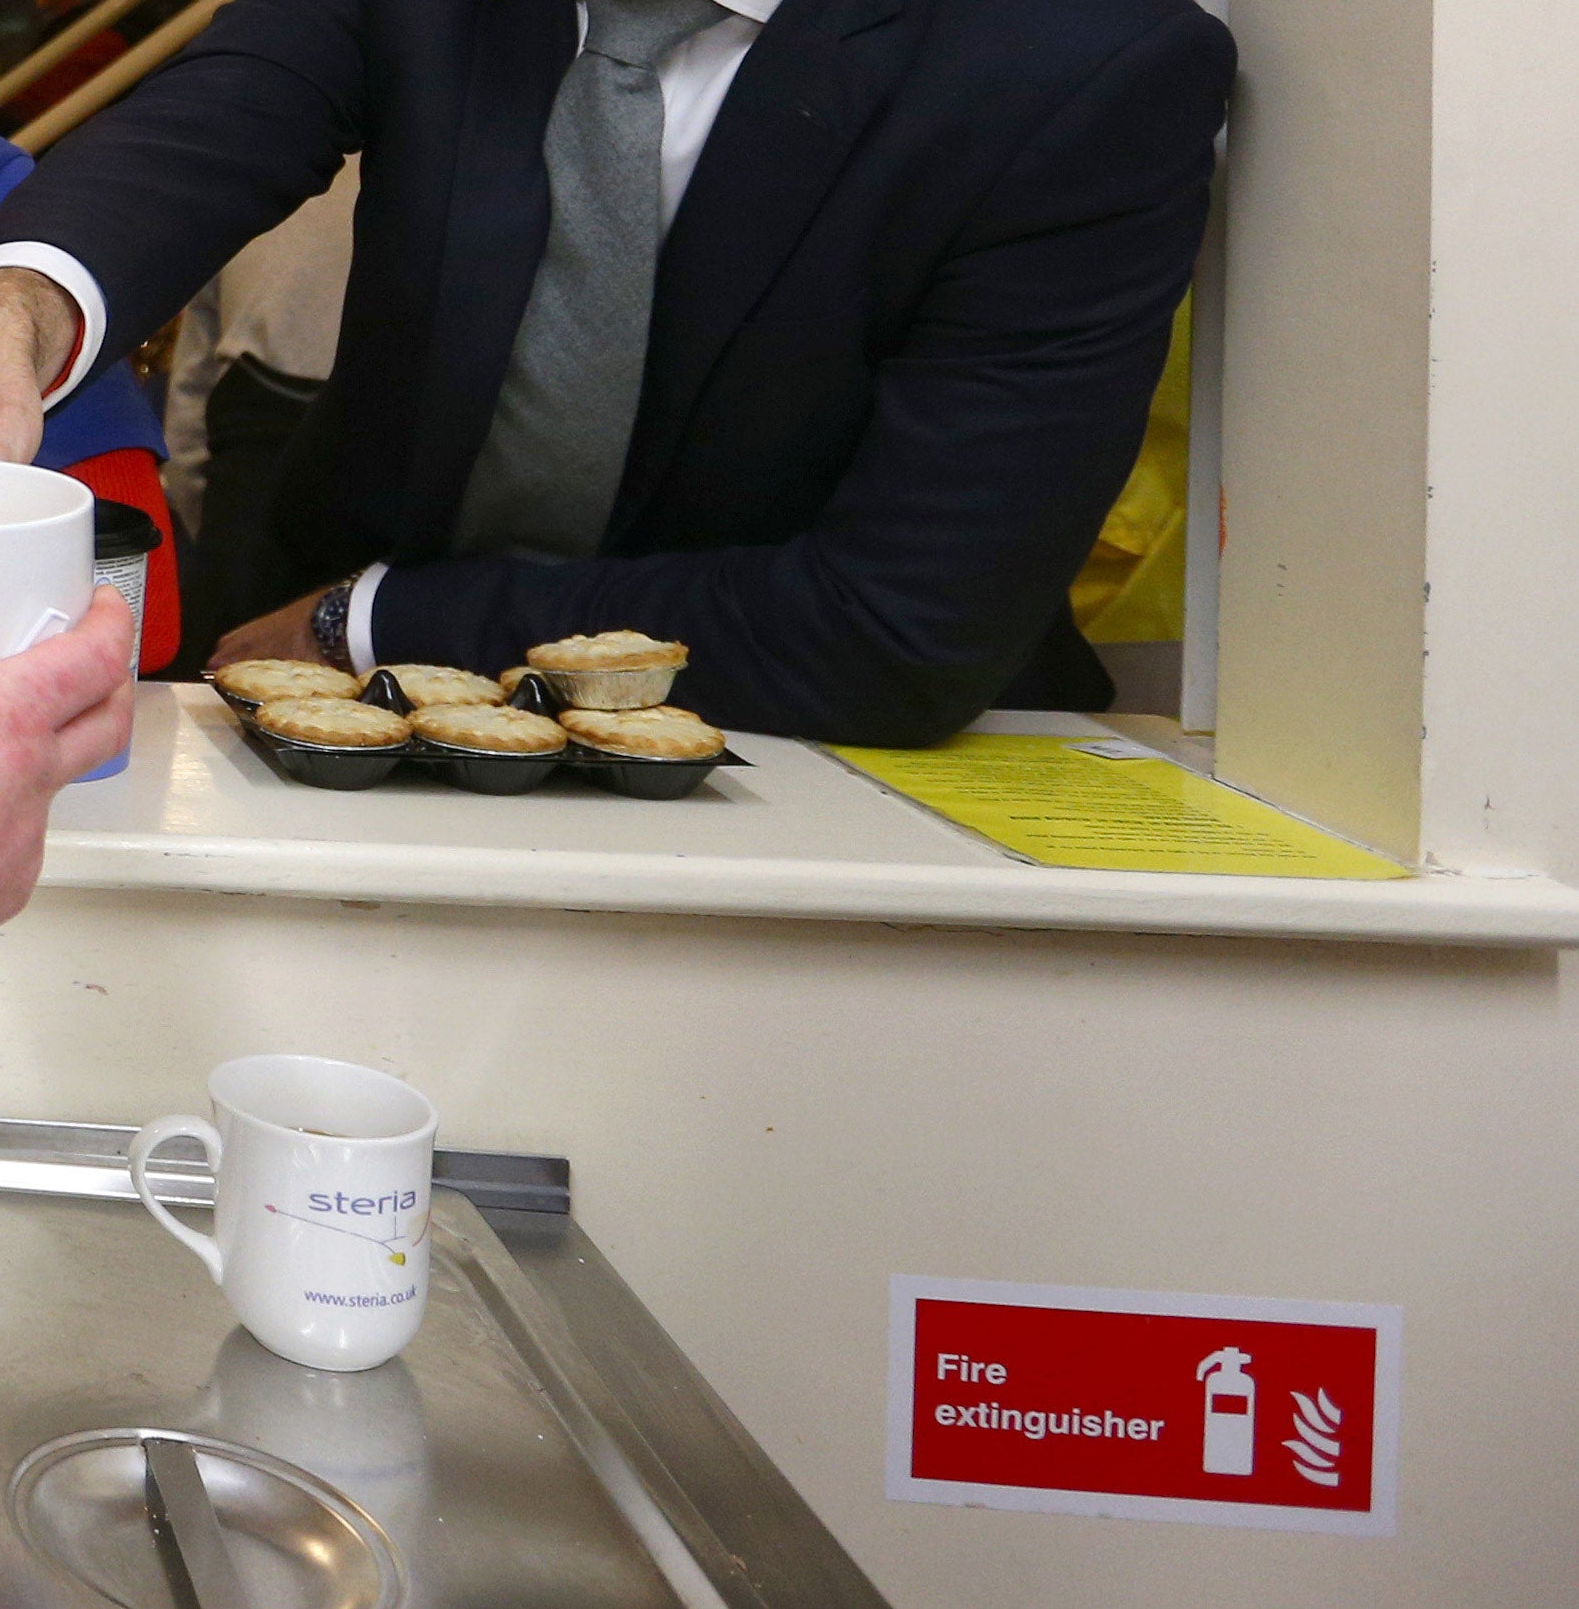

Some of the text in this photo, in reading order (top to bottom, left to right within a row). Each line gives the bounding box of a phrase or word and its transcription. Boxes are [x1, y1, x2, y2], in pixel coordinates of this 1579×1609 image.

[308, 1189, 417, 1216] steria
[304, 1283, 417, 1308] www.steria.co.uk
[937, 1352, 1008, 1385] Fire
[934, 1401, 1165, 1441] extinguisher
